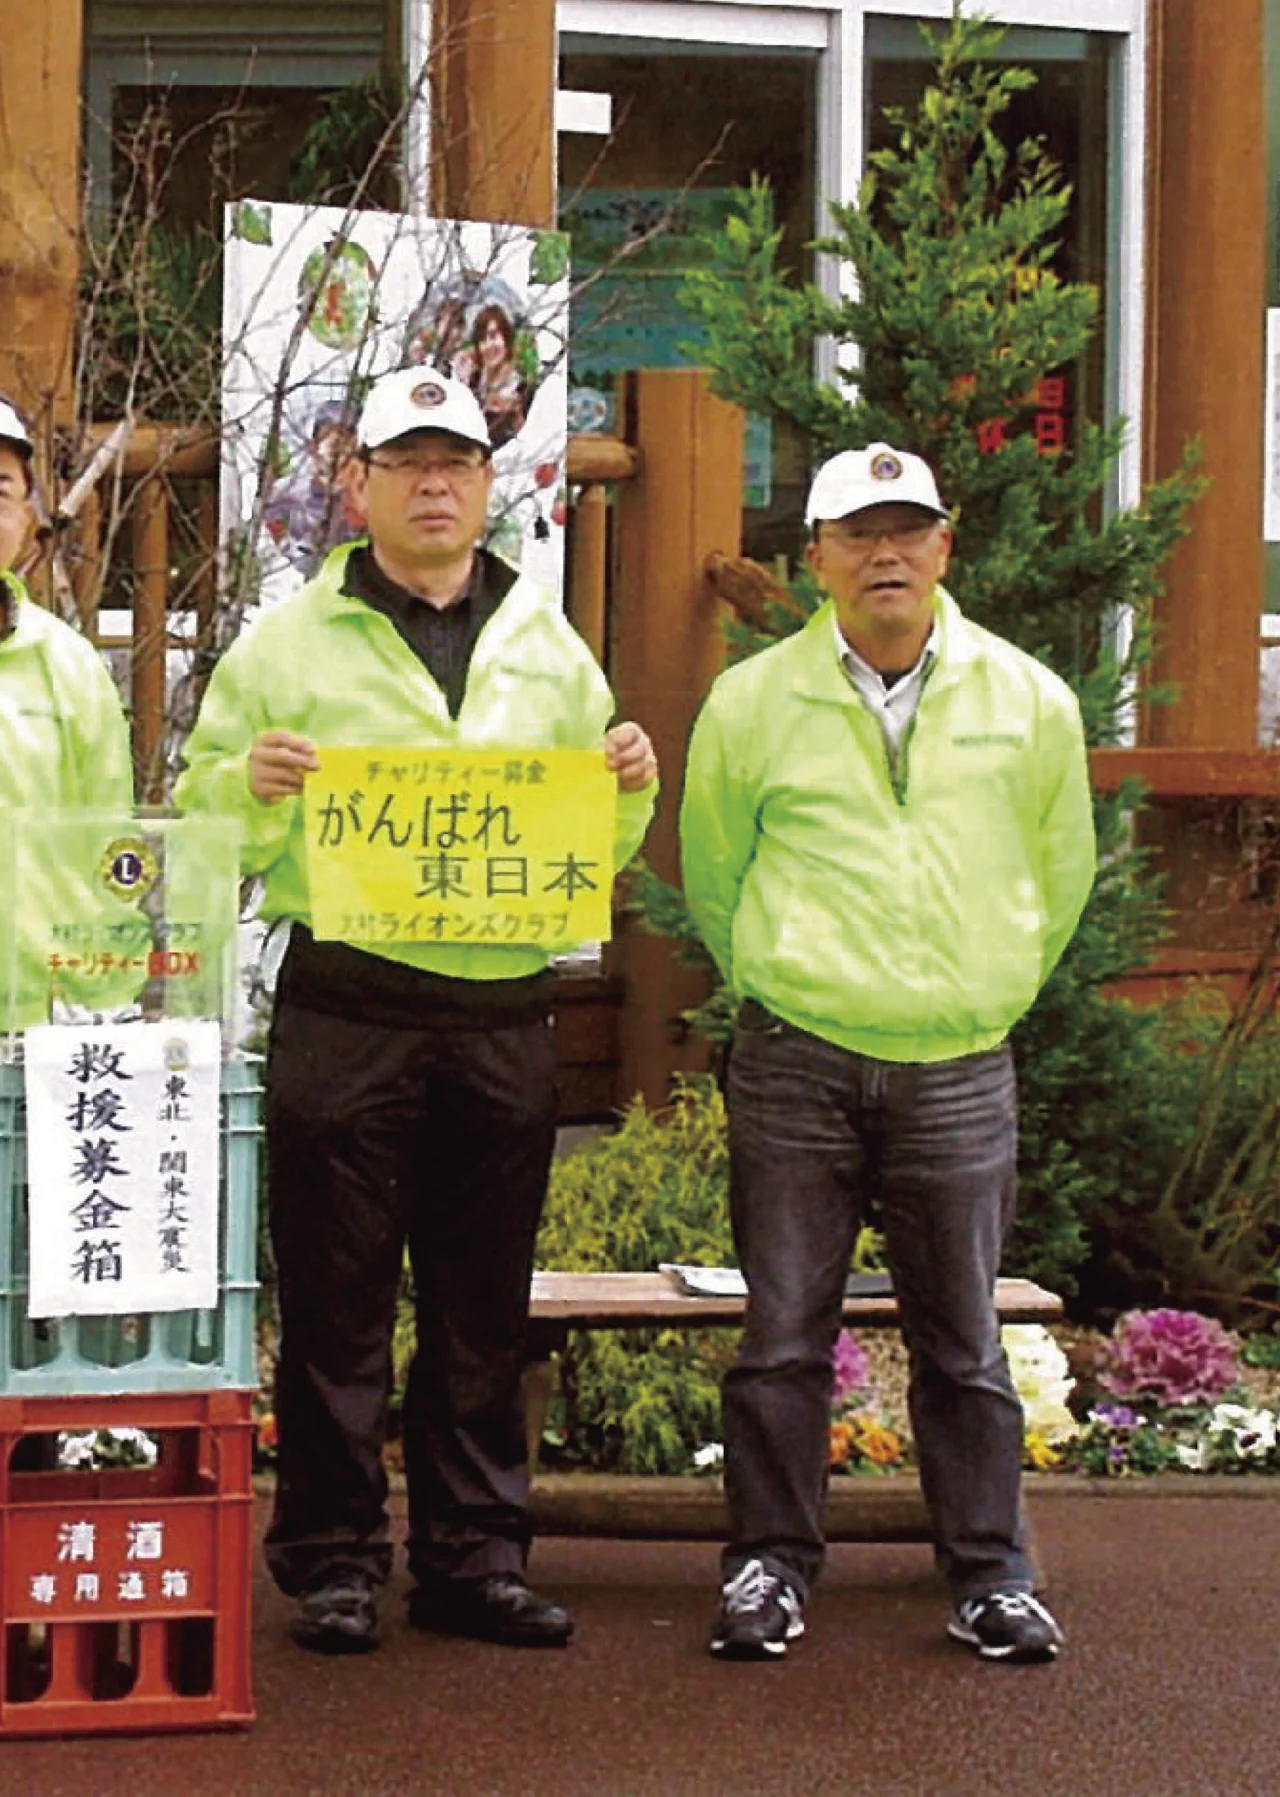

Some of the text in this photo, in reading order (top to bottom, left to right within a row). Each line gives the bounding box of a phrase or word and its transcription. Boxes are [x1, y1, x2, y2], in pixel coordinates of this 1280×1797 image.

[317, 788, 522, 851] がんばれ
[414, 851, 599, 901] 東日本
[65, 1042, 134, 1284] 救援募金箱
[56, 1520, 165, 1562] 清酒
